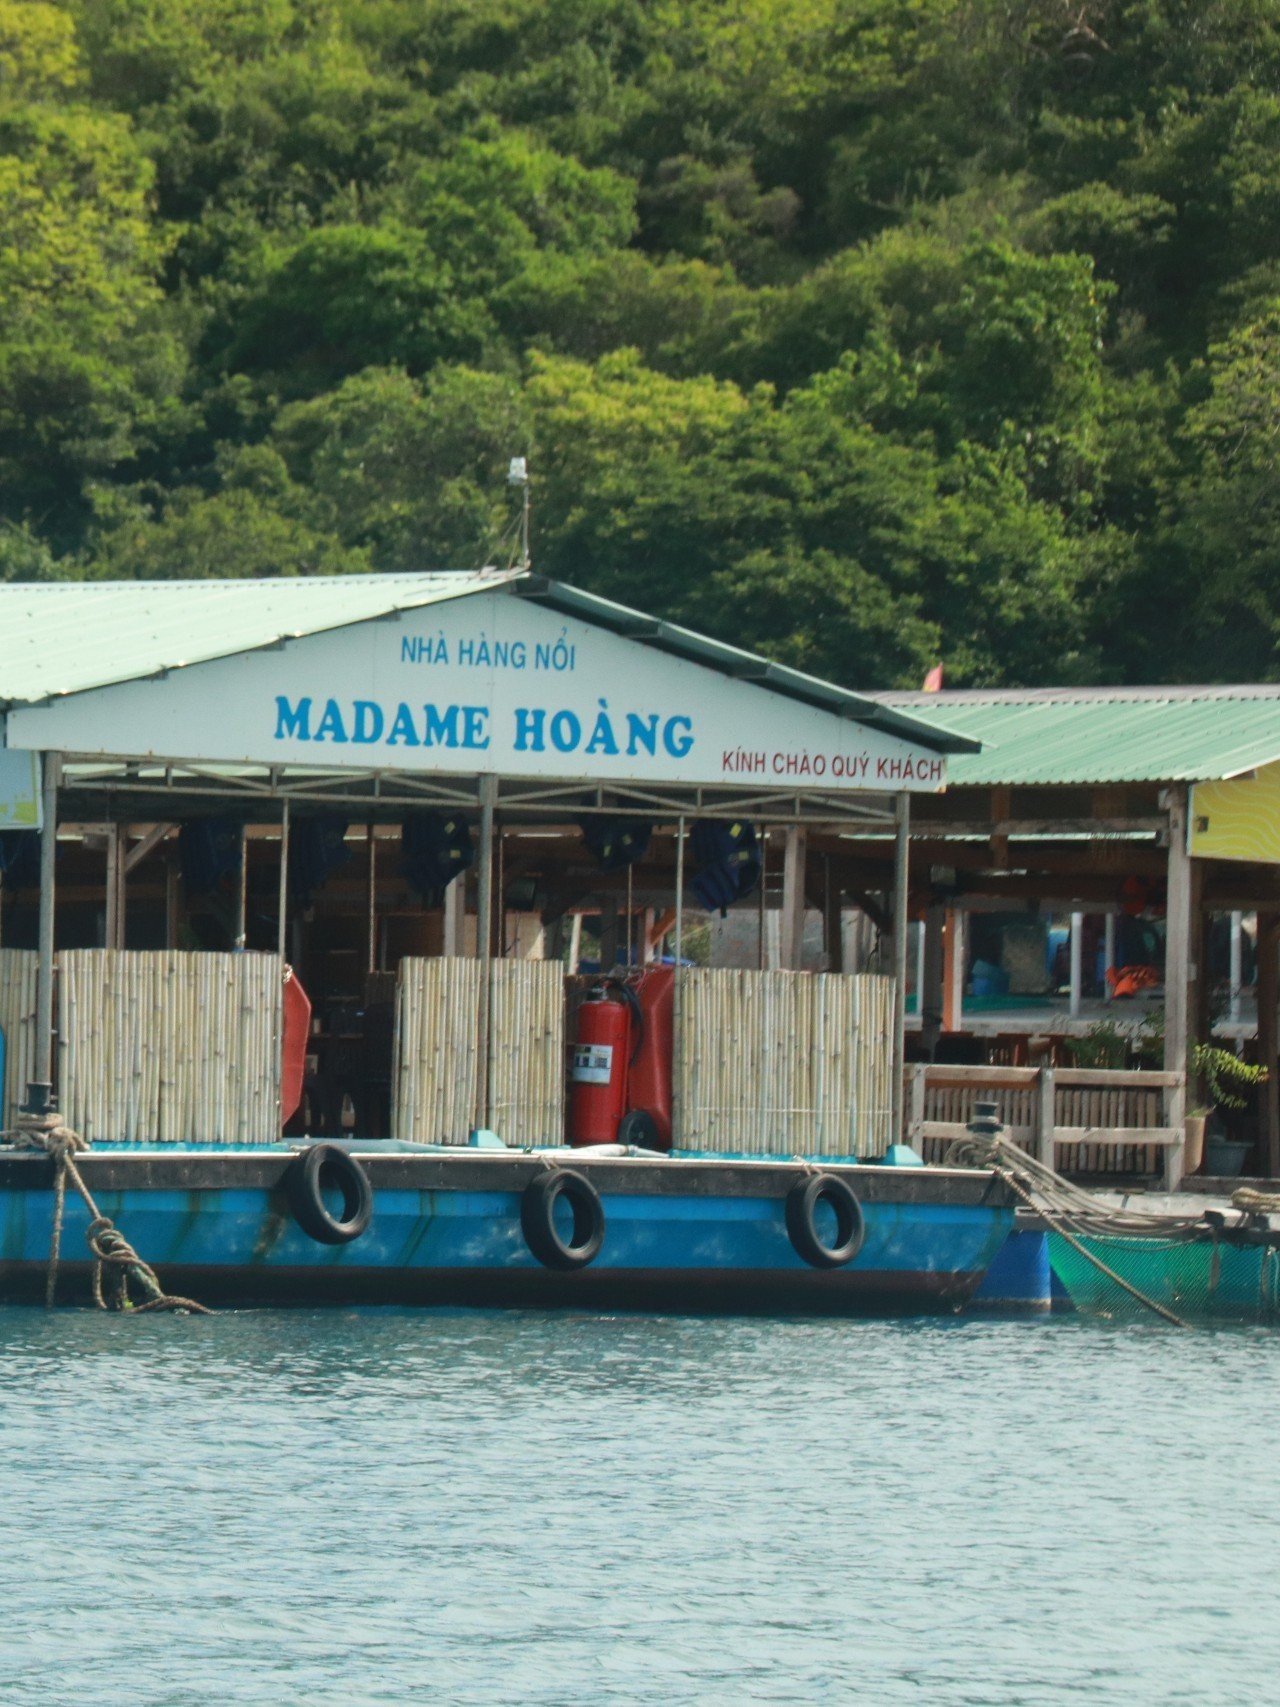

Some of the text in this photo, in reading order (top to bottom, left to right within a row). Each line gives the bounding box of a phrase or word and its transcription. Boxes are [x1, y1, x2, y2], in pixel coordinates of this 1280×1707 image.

[401, 626, 576, 671] NHÀ HÀNG NỔI
[273, 695, 694, 759] MADAME HOÀNG
[722, 745, 942, 781] KÍNH CHÀO QUÝ KHÁCH
